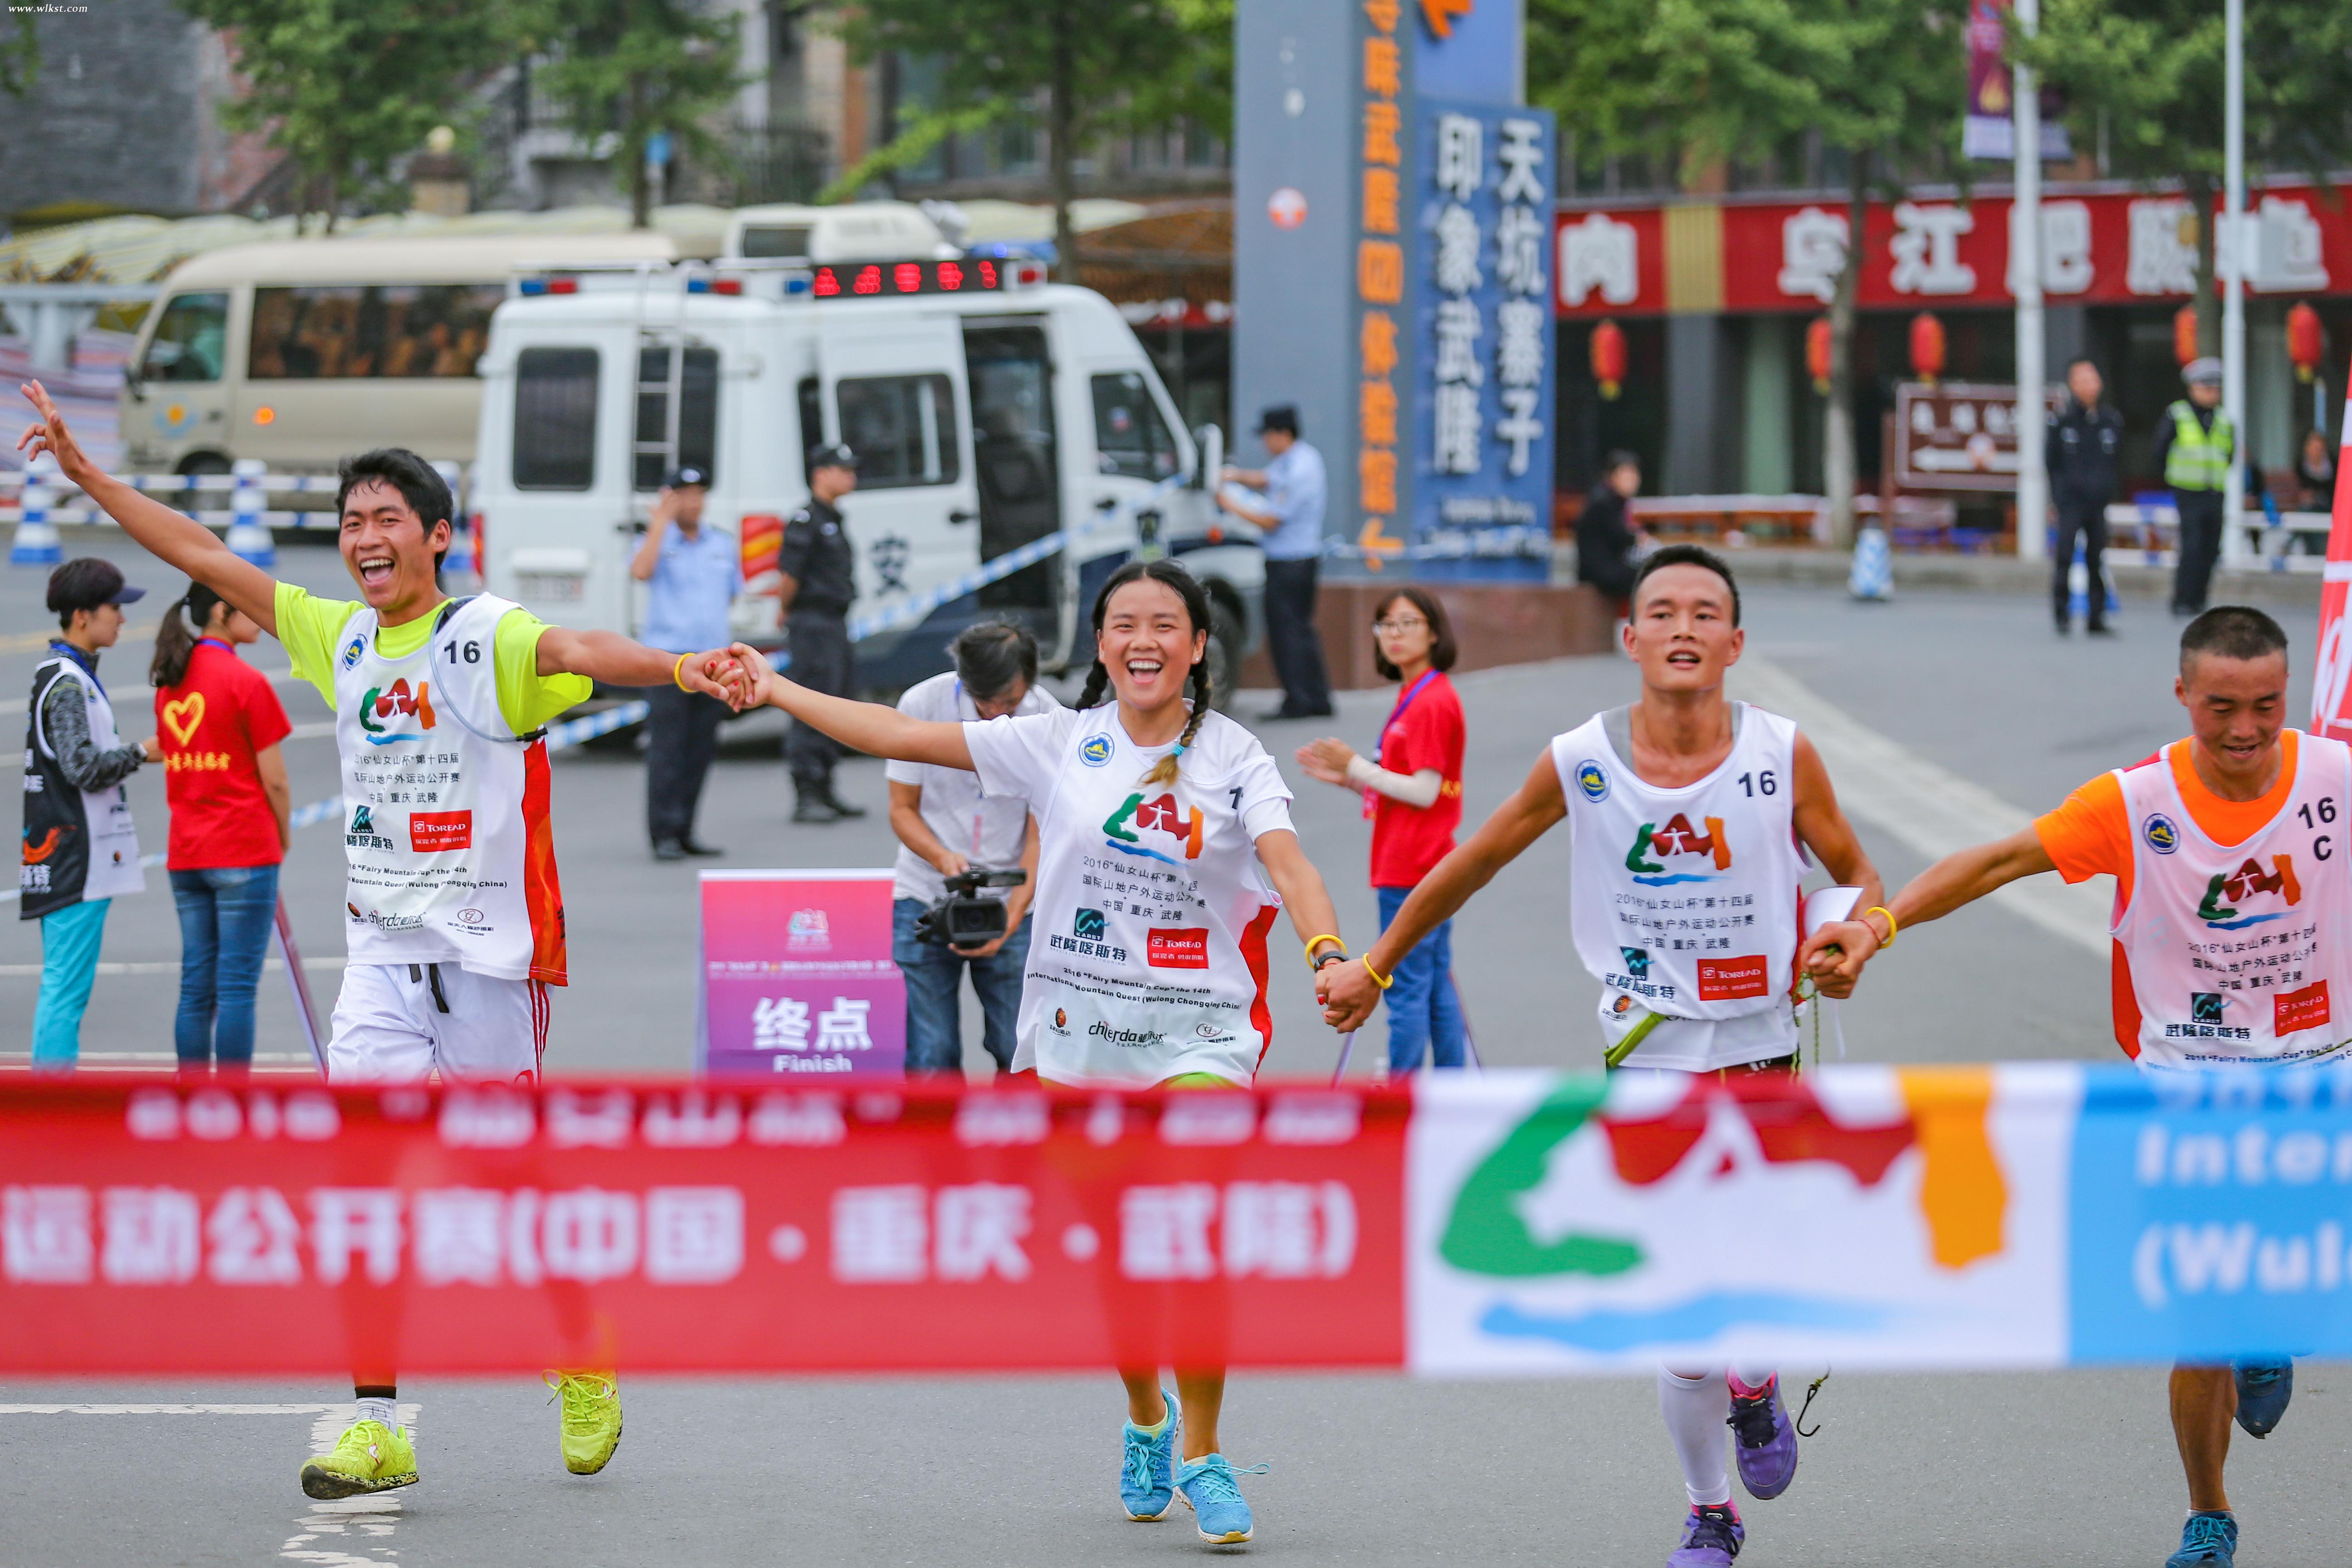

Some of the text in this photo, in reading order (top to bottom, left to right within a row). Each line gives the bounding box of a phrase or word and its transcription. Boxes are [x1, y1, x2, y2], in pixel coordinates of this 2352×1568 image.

[444, 640, 481, 664] 16
[355, 752, 459, 766] 16“仙女山杯”第十四届
[1739, 769, 1777, 798] 16
[1229, 785, 1243, 810] 1
[2298, 796, 2336, 829] 16
[426, 823, 466, 832] TOREAD
[345, 834, 393, 851] 隆喀斯特
[2313, 835, 2332, 861] C
[1620, 911, 1755, 930] 国际山地户外运动公开赛
[1076, 931, 1102, 941] KARST
[1165, 940, 1202, 948] TOREAD
[1050, 933, 1127, 962] 武隆喀斯特
[1063, 967, 1082, 977] 2016
[1111, 978, 1152, 990] Mountain
[1717, 968, 1761, 979] TOREAD
[1116, 991, 1140, 1001] Quest
[1142, 995, 1175, 1004] (Wulong
[1177, 997, 1220, 1009] Chongqing
[752, 995, 874, 1052] 终点
[2165, 1024, 2251, 1039] 武隆喀斯特
[773, 1053, 853, 1073] Finish
[2239, 1055, 2282, 1063] Mountain
[2132, 1220, 2352, 1309] (Wul
